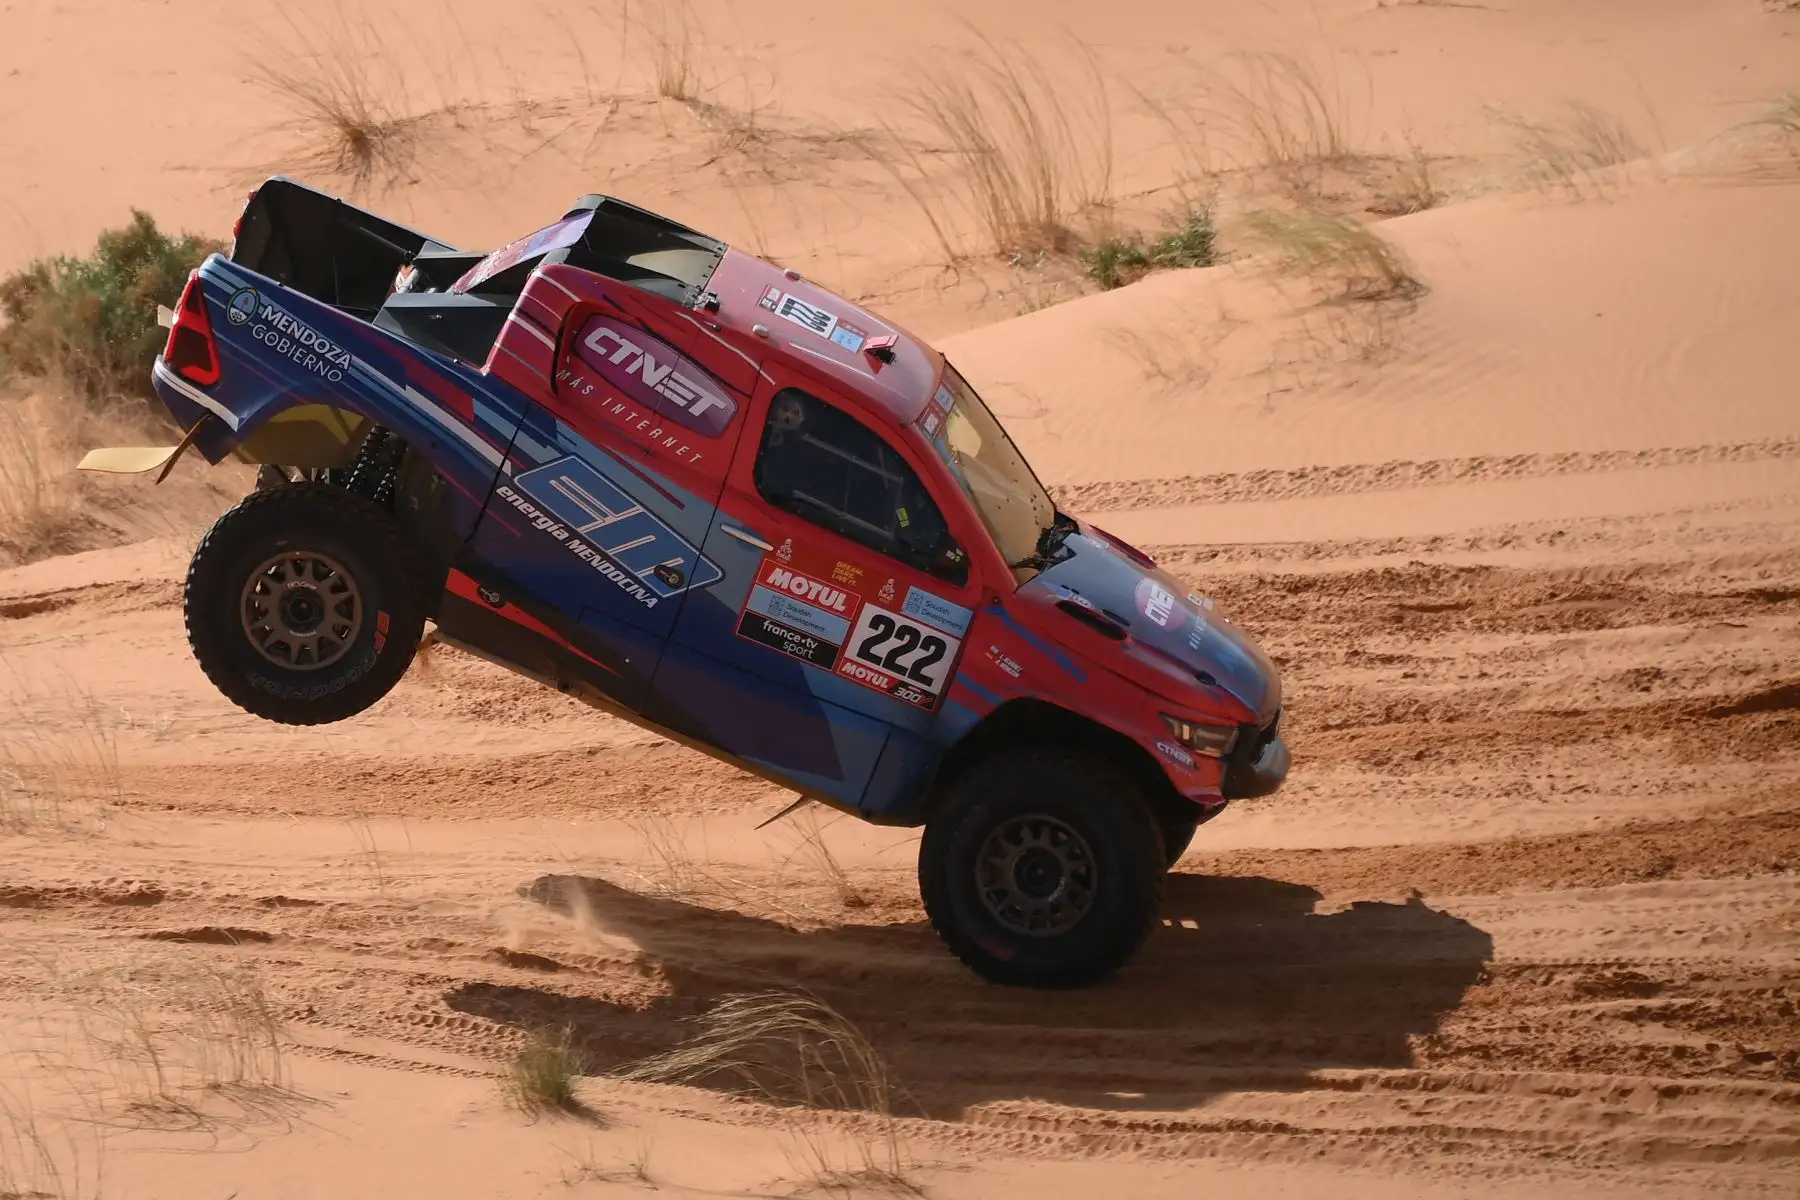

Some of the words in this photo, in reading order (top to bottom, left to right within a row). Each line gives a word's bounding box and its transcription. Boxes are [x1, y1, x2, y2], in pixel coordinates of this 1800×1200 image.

[261, 305, 353, 370] MENDOZA
[780, 298, 831, 332] 222
[252, 324, 342, 382] GOBIERNO
[584, 327, 727, 417] CTNET
[557, 370, 594, 395] MÁS
[601, 397, 702, 463] INTERNET
[496, 486, 569, 541] energía
[565, 539, 659, 609] MENDOCINA
[766, 567, 846, 612] MOTUL
[782, 640, 814, 659] sport
[841, 662, 888, 688] MOTUL
[856, 614, 947, 687] 222
